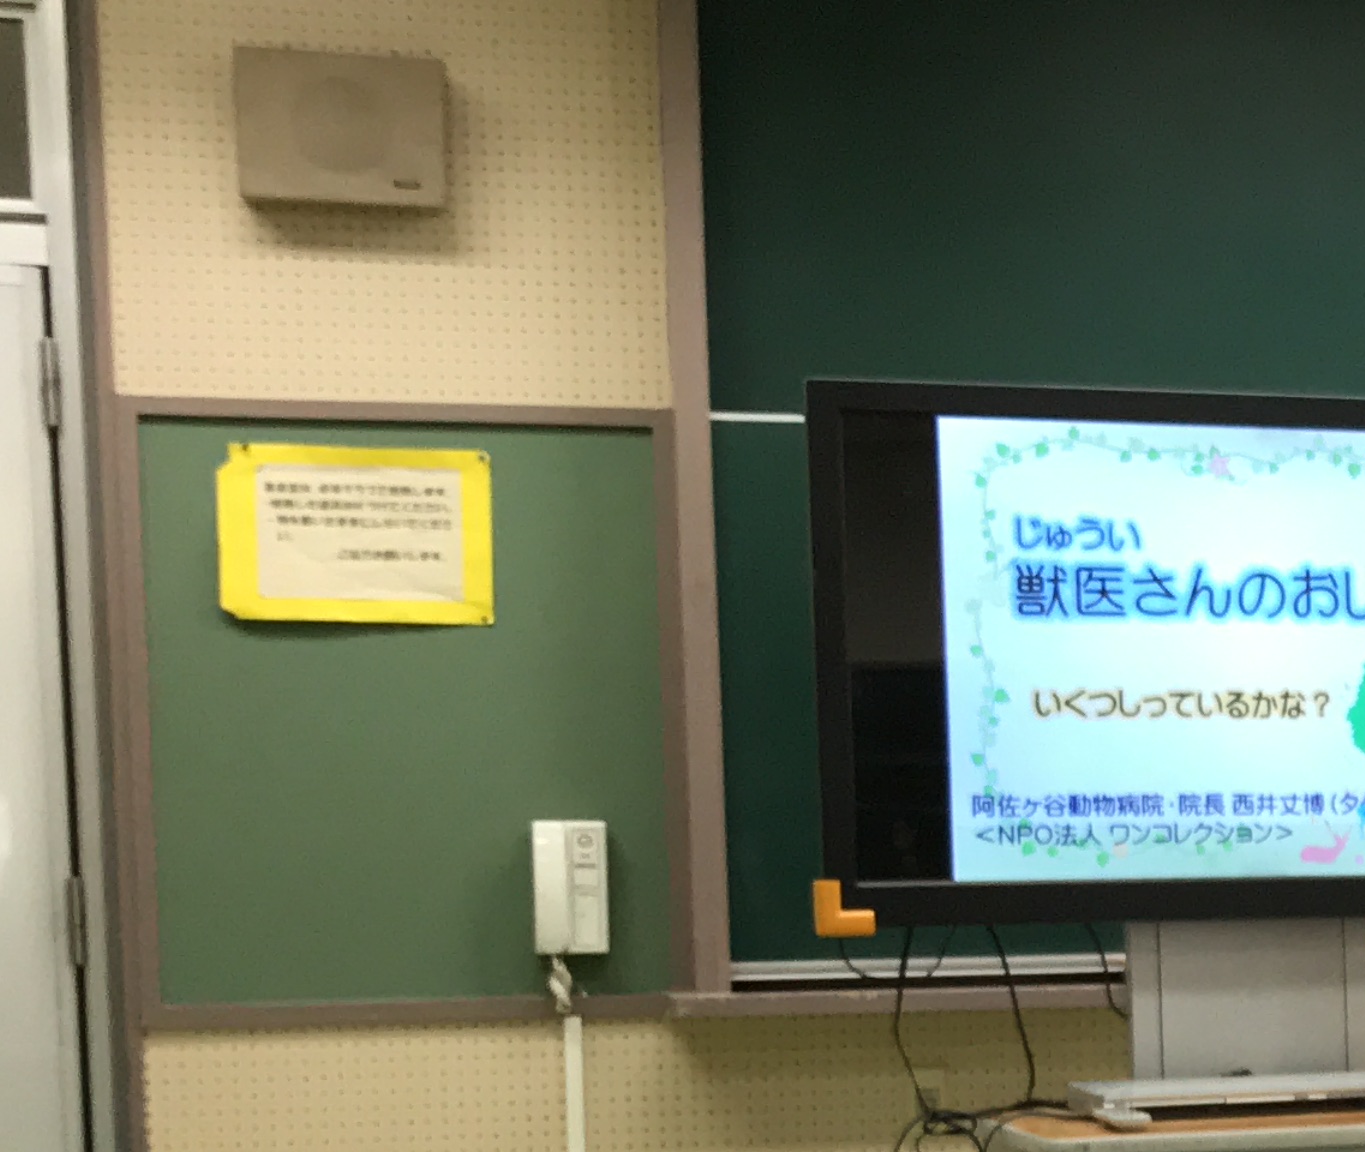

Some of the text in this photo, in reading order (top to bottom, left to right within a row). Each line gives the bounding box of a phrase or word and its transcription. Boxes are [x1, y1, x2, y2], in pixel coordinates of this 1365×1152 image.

[1014, 517, 1141, 551] じゅうい
[1033, 689, 1331, 719] いくつしっているかな？
